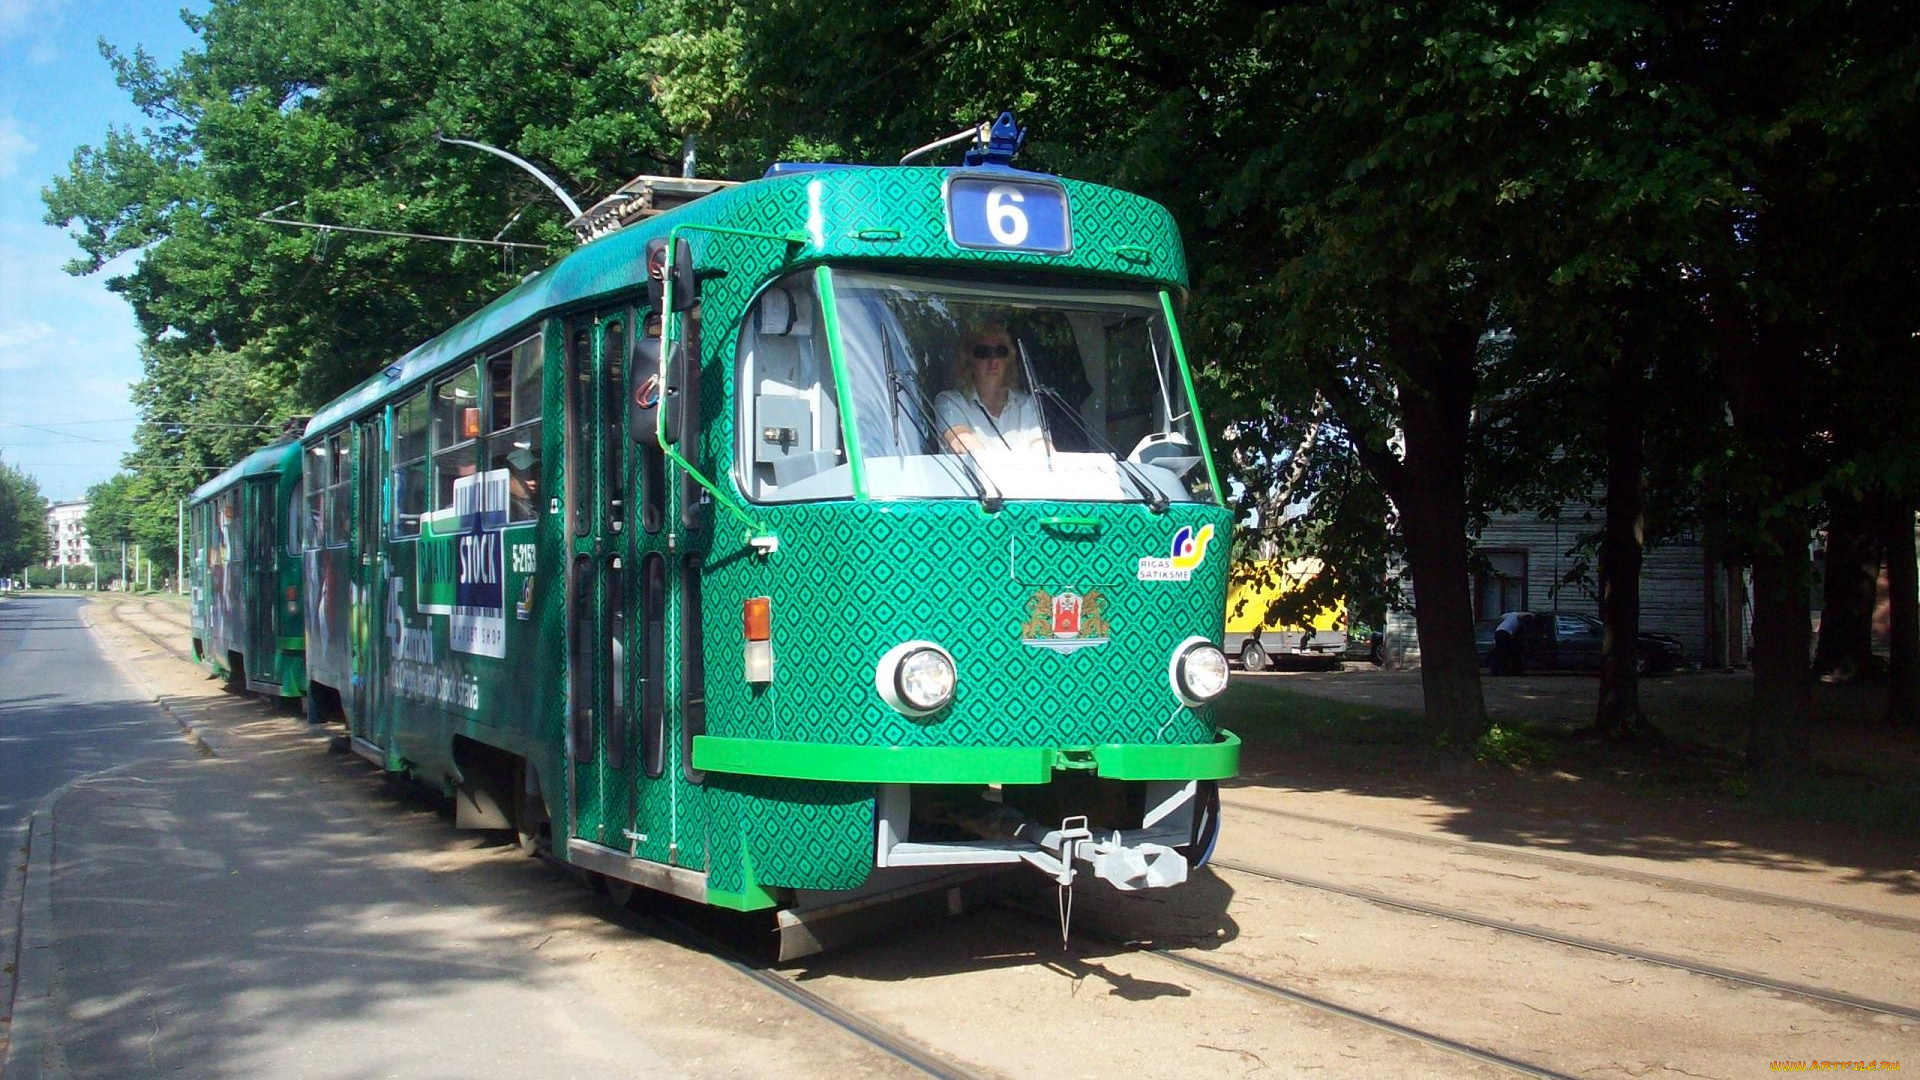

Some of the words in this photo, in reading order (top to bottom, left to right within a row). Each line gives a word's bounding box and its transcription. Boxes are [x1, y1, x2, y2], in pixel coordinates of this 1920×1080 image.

[986, 185, 1029, 245] 6
[460, 534, 496, 584] STOCK
[513, 544, 537, 572] 5-2153
[482, 628, 501, 645] SHOP
